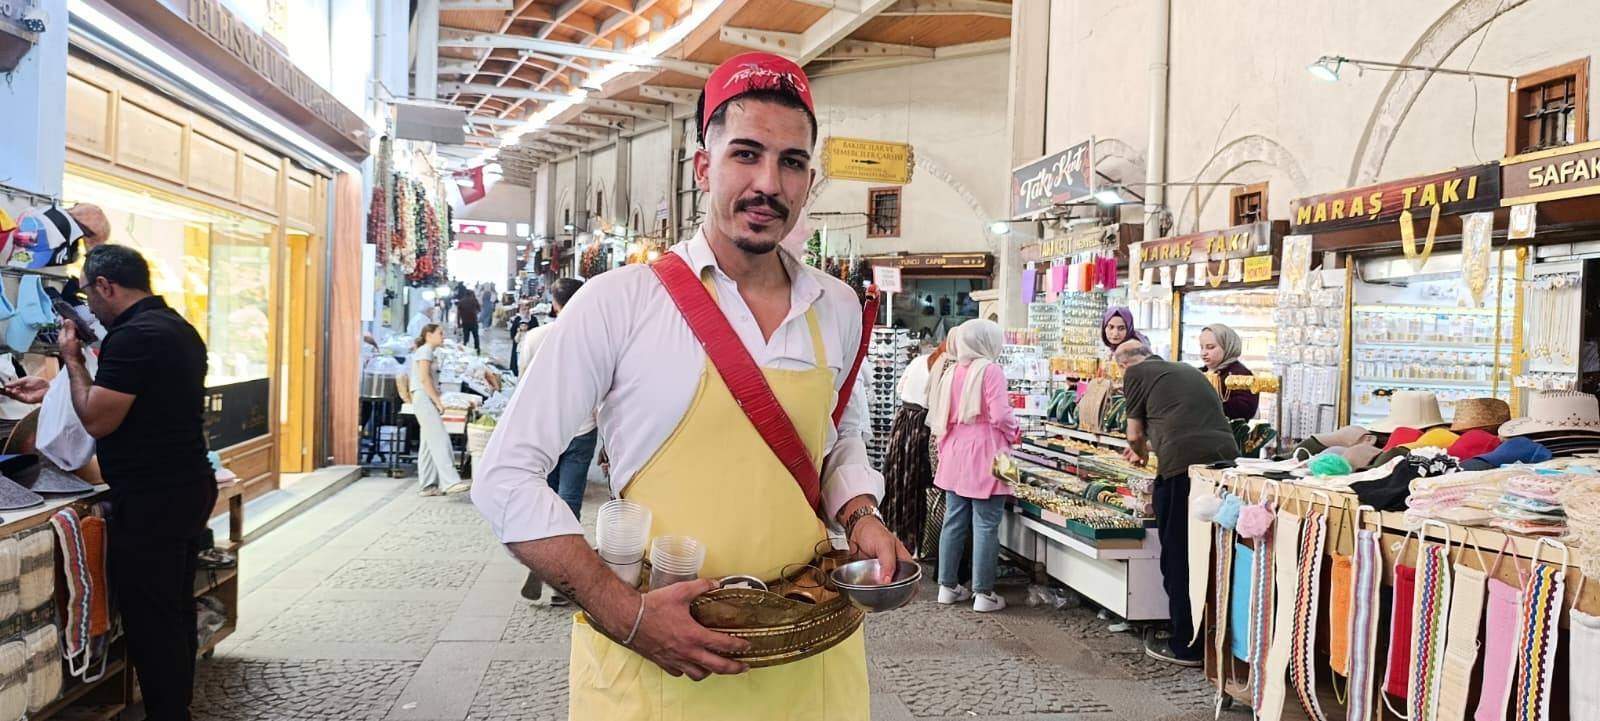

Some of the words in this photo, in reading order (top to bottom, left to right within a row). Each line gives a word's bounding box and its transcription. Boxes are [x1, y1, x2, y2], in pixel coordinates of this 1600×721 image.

[1296, 191, 1384, 226] MARAŞ
[1401, 175, 1478, 210] TAKI
[1139, 240, 1193, 262] MARAŞ
[1206, 231, 1250, 254] TAKI
